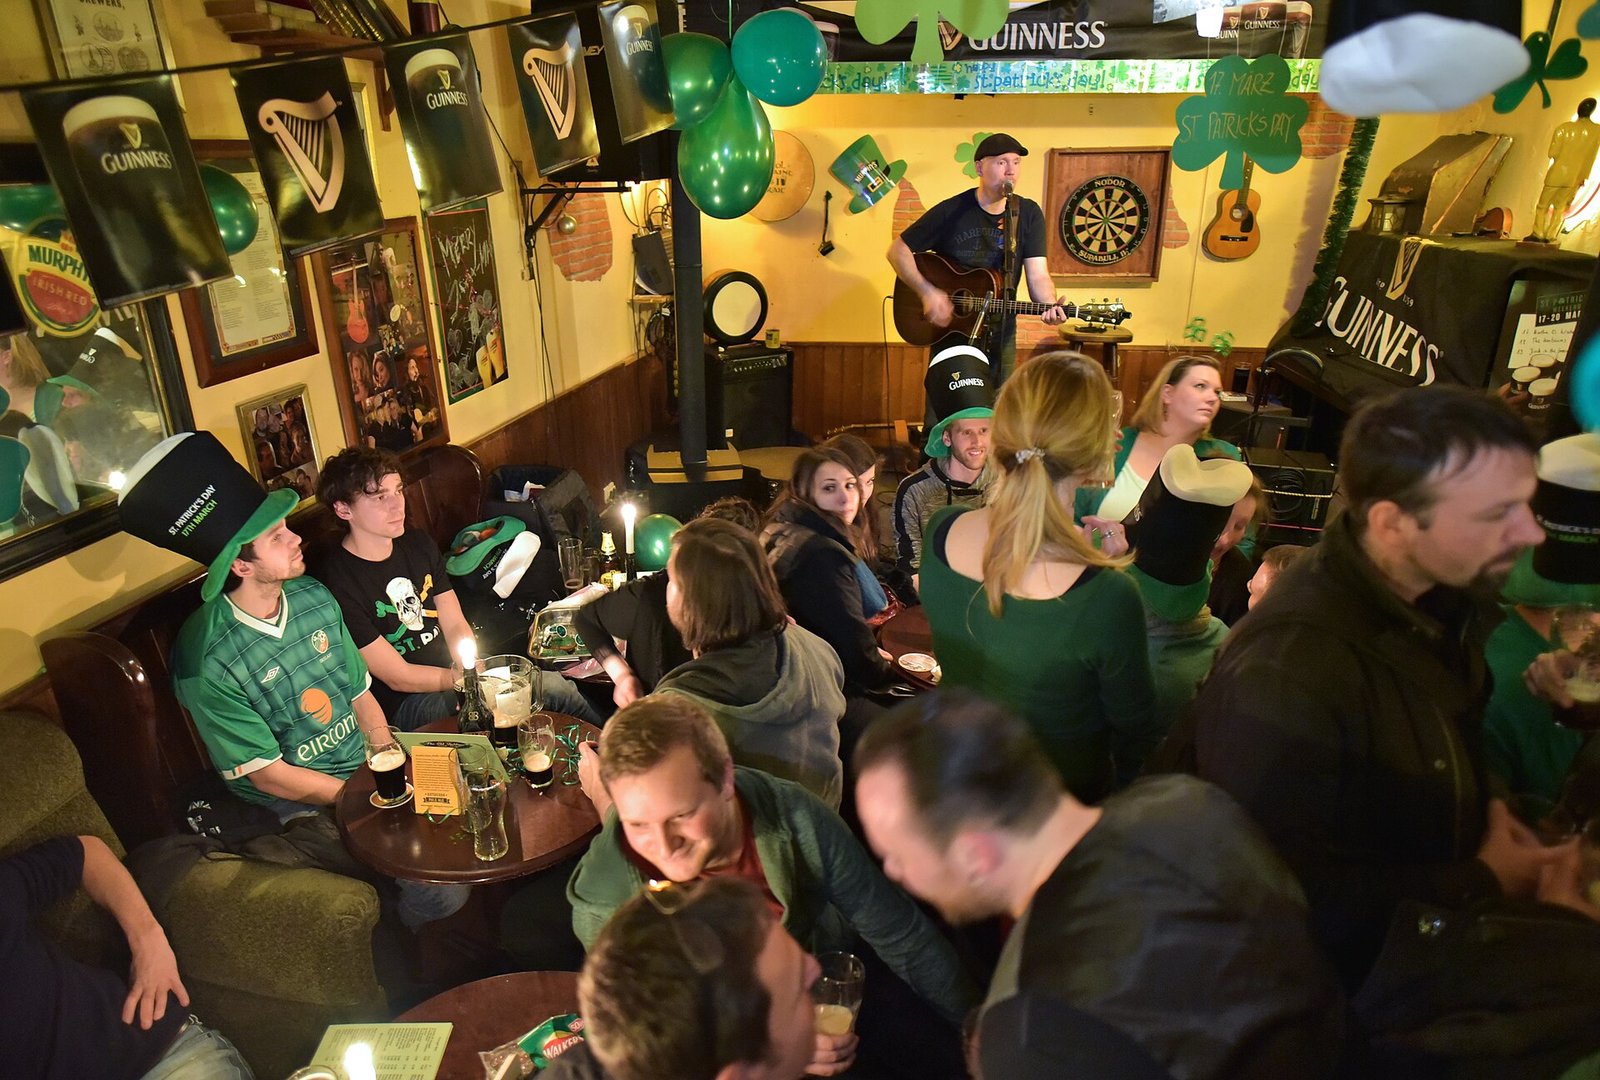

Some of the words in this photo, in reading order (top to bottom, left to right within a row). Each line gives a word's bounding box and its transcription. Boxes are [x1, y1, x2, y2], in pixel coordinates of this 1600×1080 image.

[1244, 20, 1280, 29] GUINNESS
[426, 91, 468, 110] GUINNESS
[101, 150, 172, 175] GUINNESS
[1094, 179, 1126, 188] NODOR
[32, 276, 64, 297] IRISH
[65, 289, 88, 306] RED
[1538, 312, 1561, 324] 17-20
[948, 378, 985, 391] GUINNESS
[168, 526, 180, 536] ST.
[175, 497, 205, 528] PATRICK'S
[200, 484, 217, 500] DAY
[181, 522, 197, 537] 17TH
[192, 499, 218, 525] MARCH
